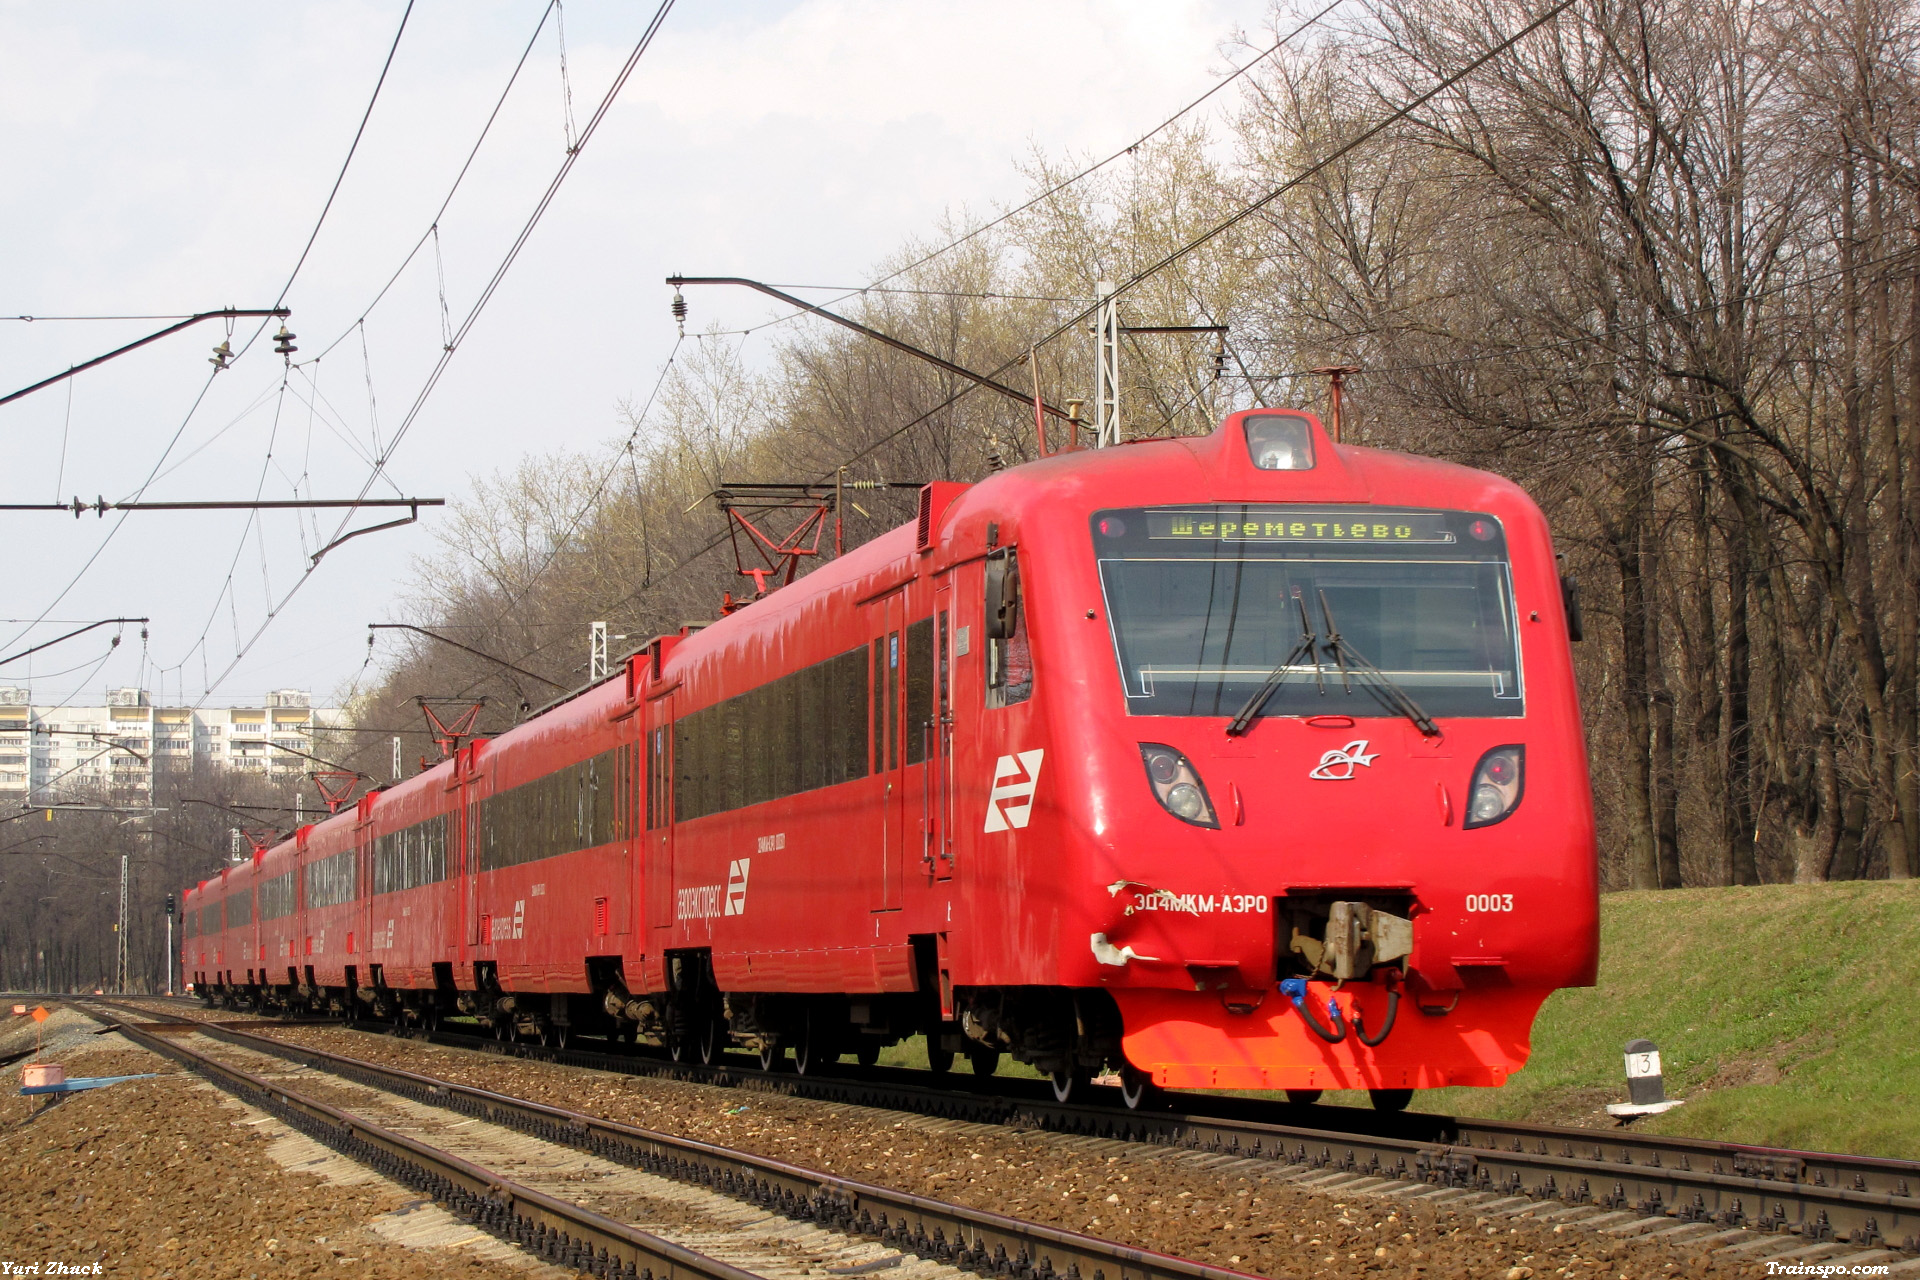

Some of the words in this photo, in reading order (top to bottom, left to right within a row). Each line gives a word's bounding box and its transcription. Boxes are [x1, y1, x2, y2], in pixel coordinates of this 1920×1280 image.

[1171, 516, 1412, 538] Шереметьево
[1465, 893, 1514, 912] 0003
[1640, 1054, 1651, 1074] 3
